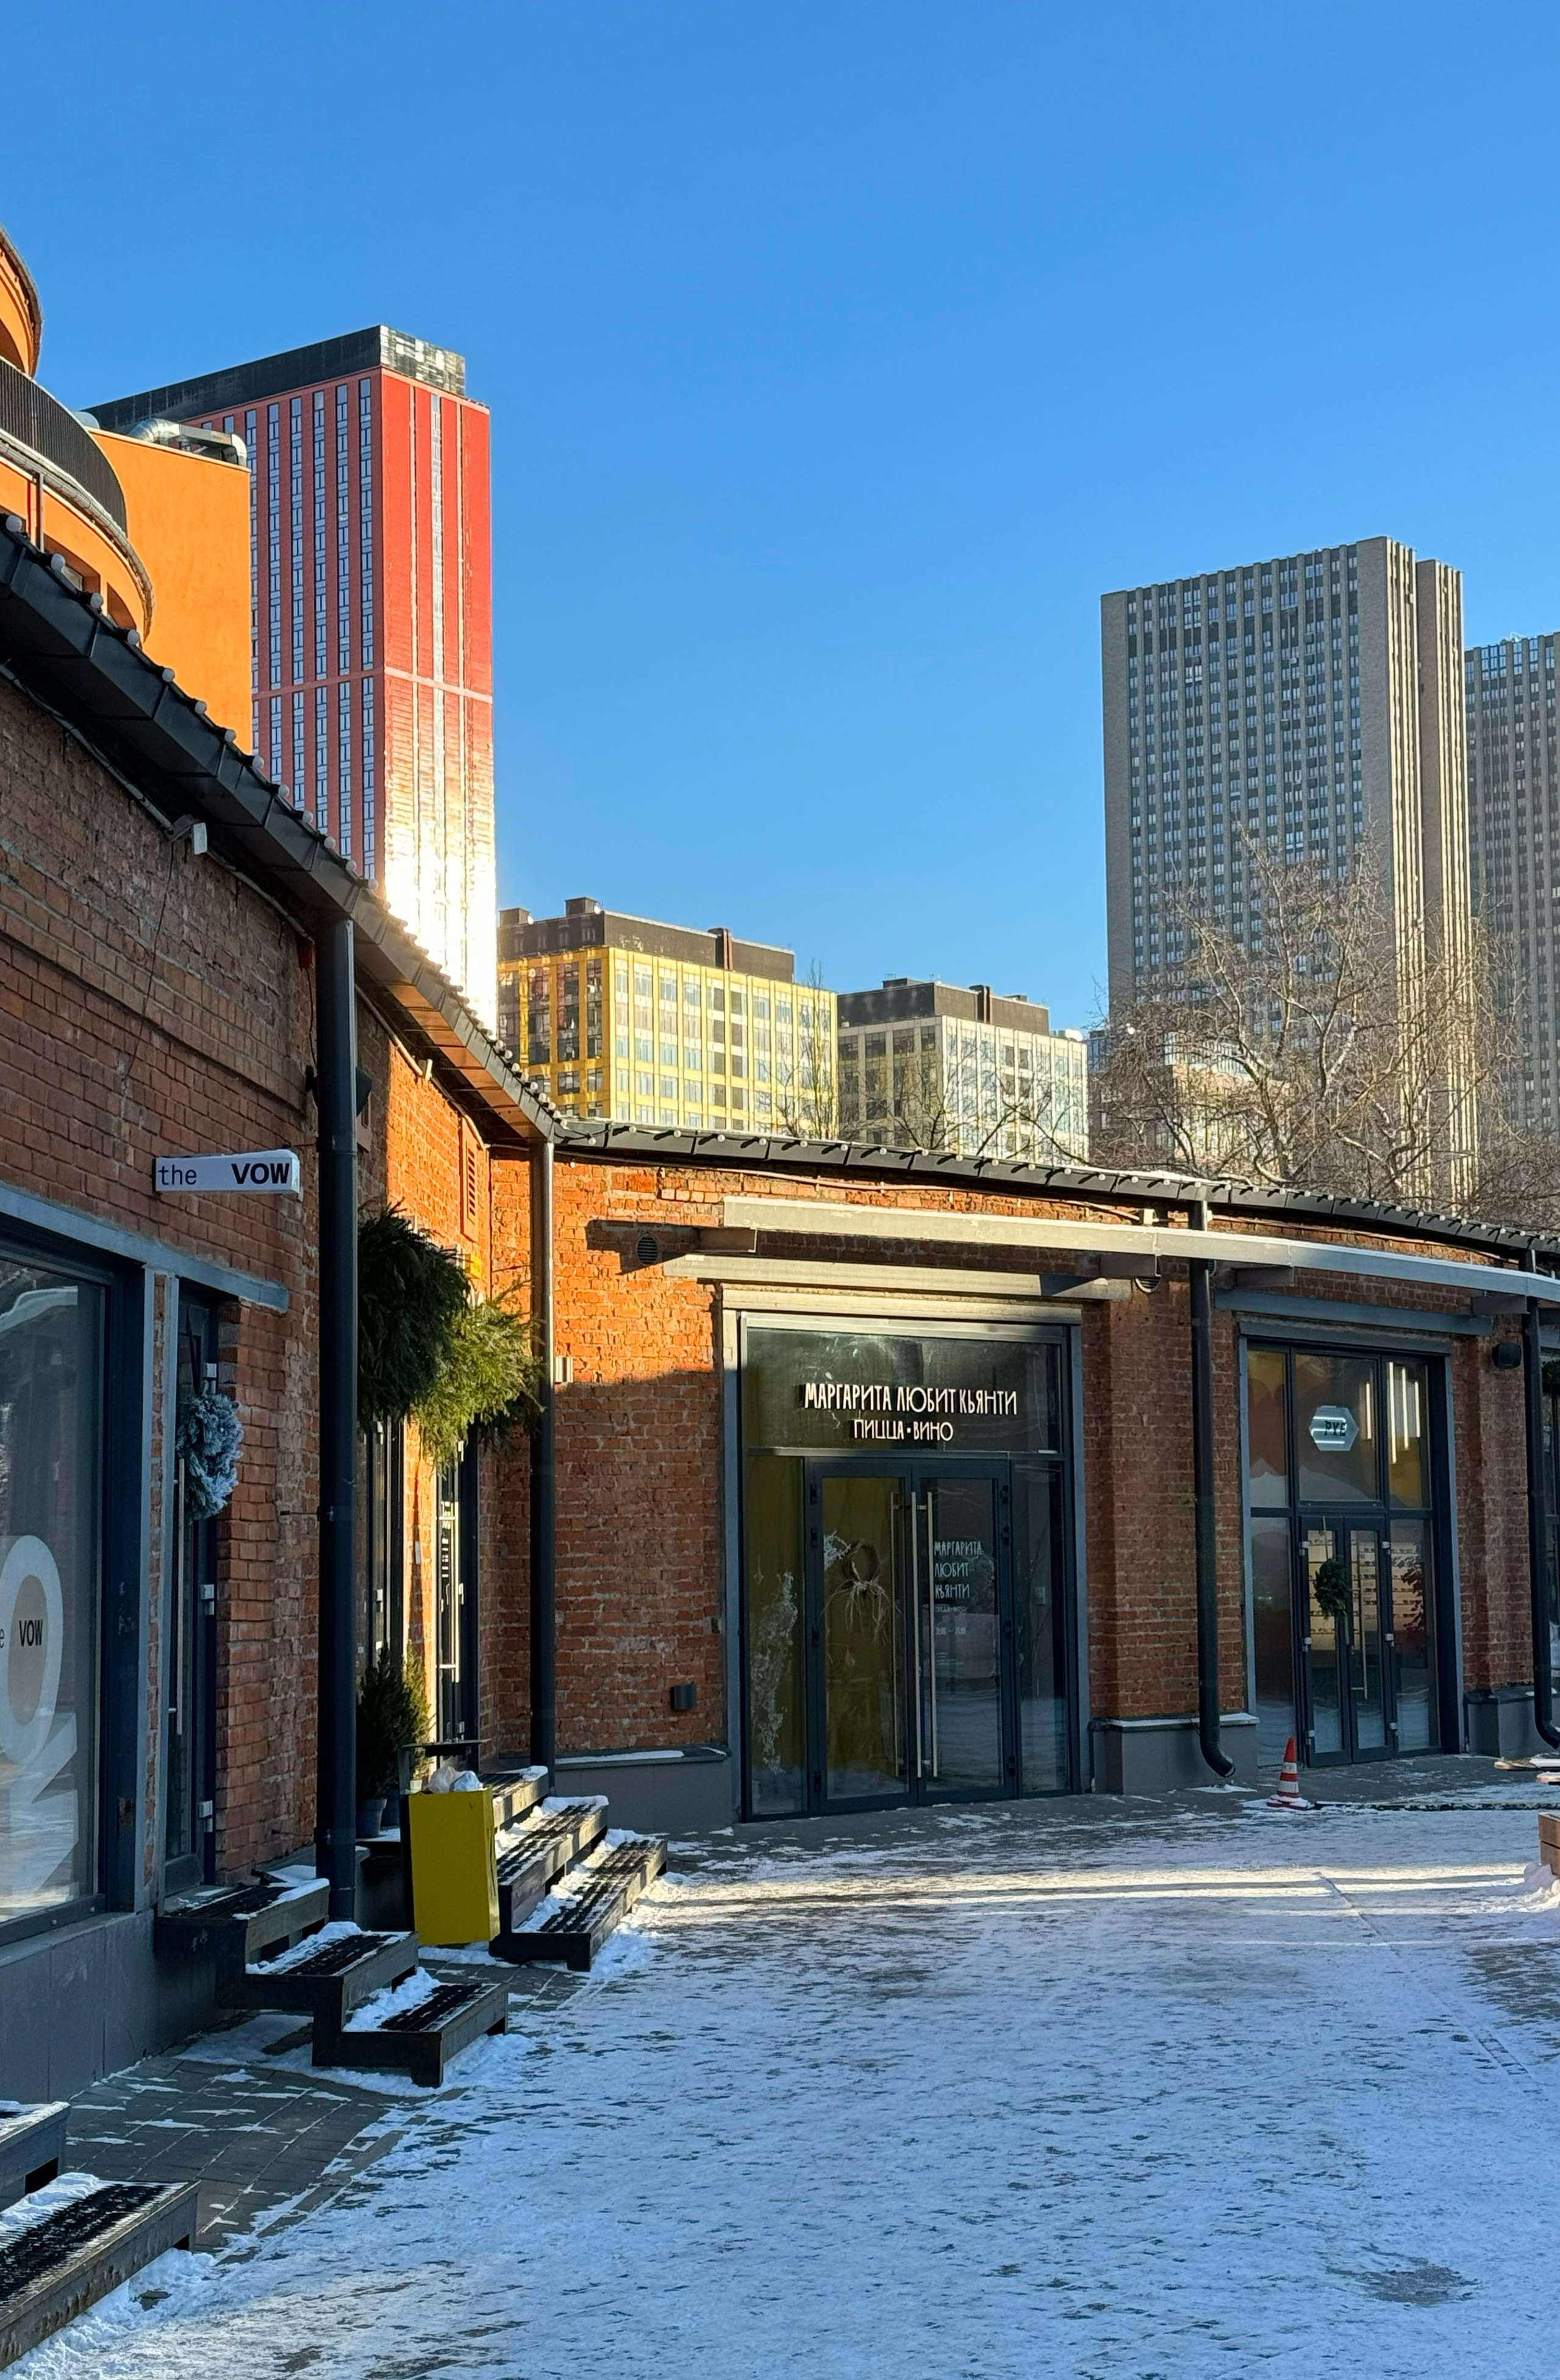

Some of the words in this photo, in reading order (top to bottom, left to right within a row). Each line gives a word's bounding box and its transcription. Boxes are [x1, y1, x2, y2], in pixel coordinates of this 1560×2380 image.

[158, 1164, 197, 1185] the
[231, 1163, 290, 1184] VOW
[804, 1383, 891, 1411] МАРГАРИТА
[896, 1387, 957, 1413] ЛЮБИТ
[959, 1389, 1017, 1415] КЬЯНТИ
[934, 1540, 982, 1556] МАРГАРИТА
[934, 1562, 970, 1577] ЛЮБИТ
[934, 1584, 970, 1599] КЬЯНТИ
[18, 1619, 43, 1647] VOW
